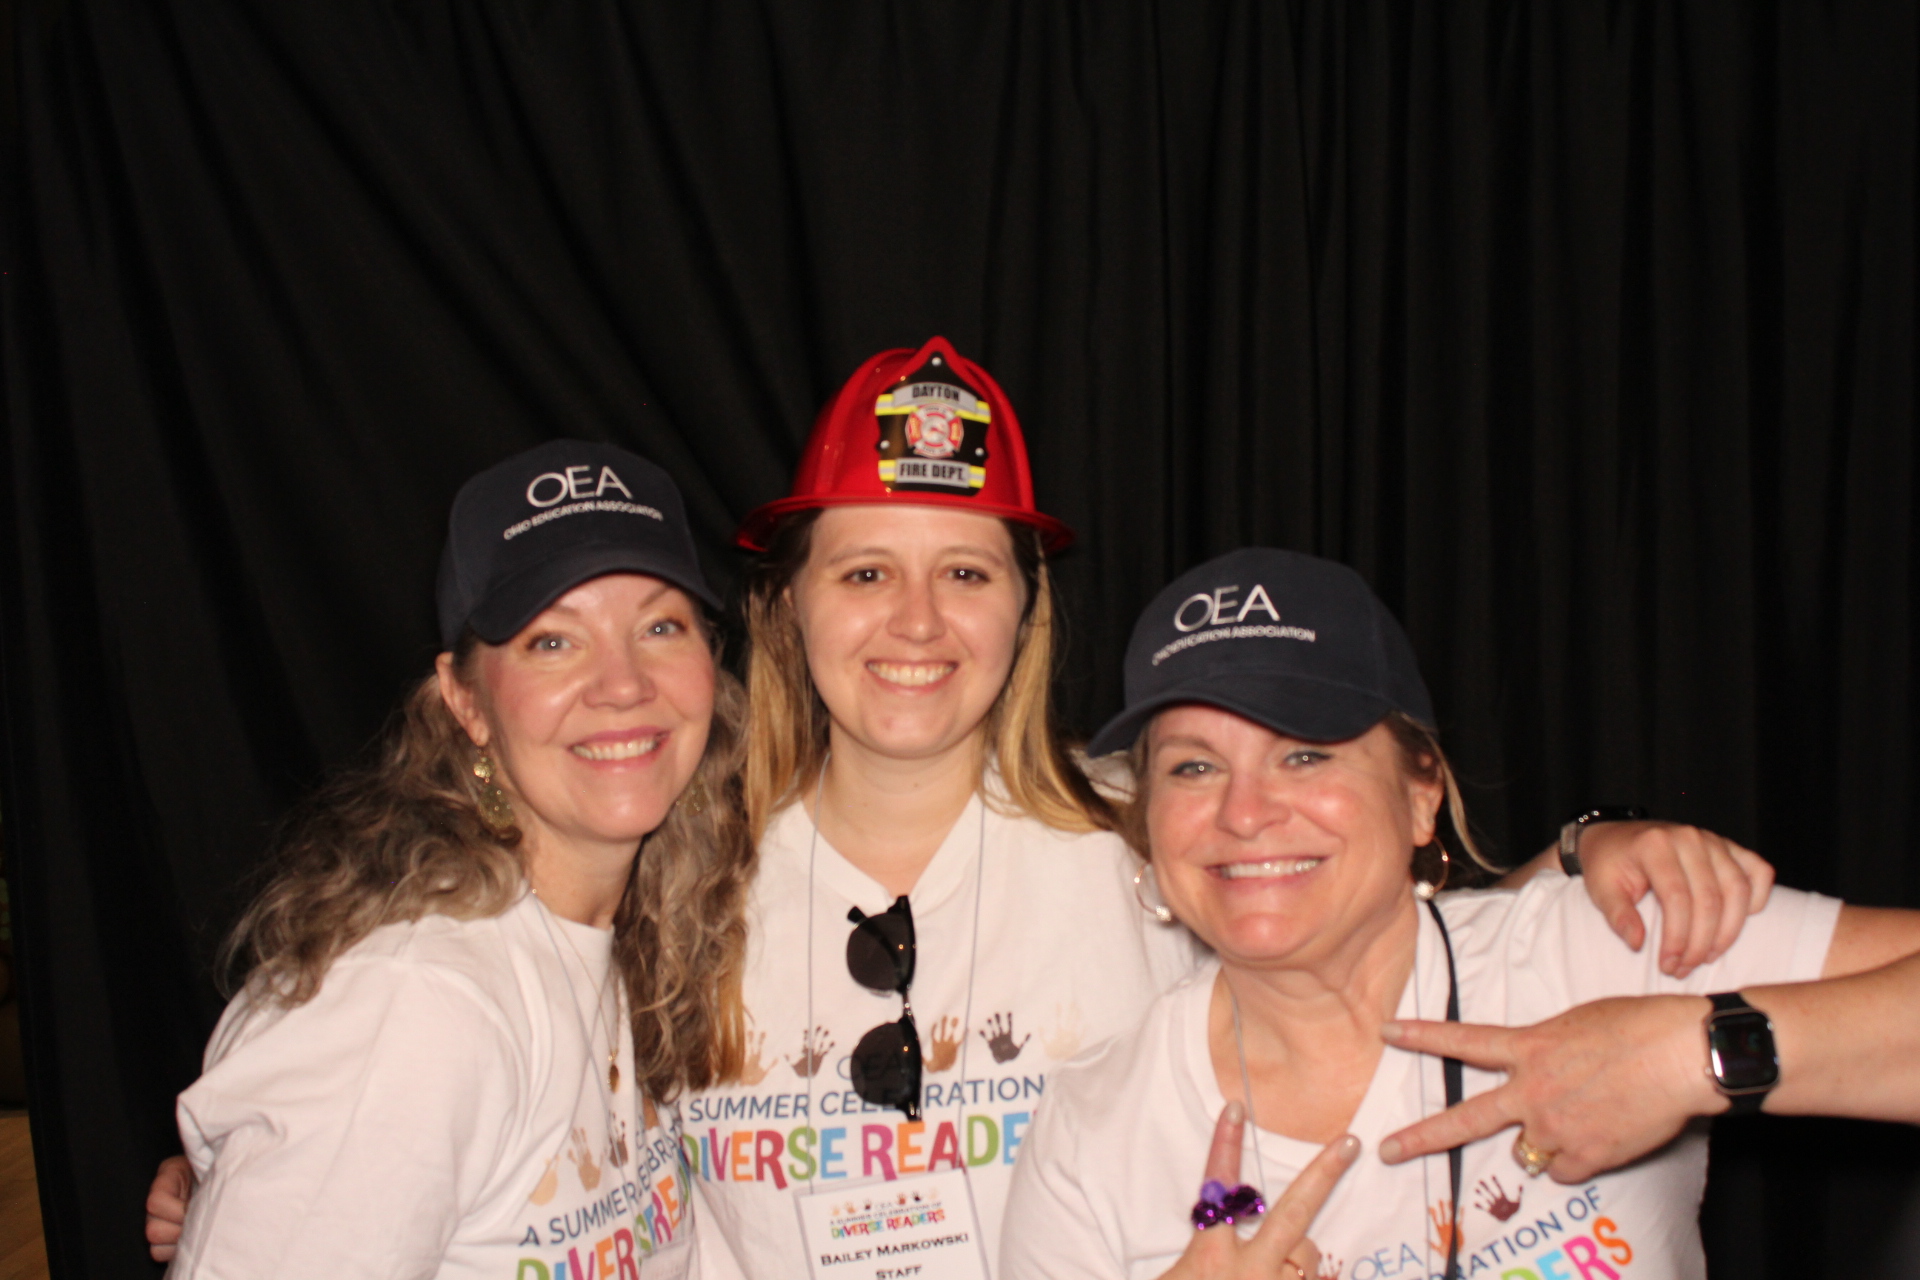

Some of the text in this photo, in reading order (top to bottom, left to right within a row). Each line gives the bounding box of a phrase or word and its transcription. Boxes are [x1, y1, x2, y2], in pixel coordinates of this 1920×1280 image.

[912, 385, 959, 401] DAYTON
[899, 463, 927, 477] FIRE
[526, 465, 633, 508] OEA
[503, 519, 532, 540] OHIO
[1173, 584, 1281, 633] OEA
[1230, 625, 1316, 642] ASSOCIATION
[689, 1093, 810, 1122] SUMMER
[518, 1224, 541, 1247] A
[549, 1181, 637, 1245] SUMMER
[1566, 1186, 1601, 1221] OF
[831, 1208, 945, 1239] DIVERSE READERS
[821, 1234, 969, 1266] BAILEY MARKOWSKI
[1350, 1243, 1425, 1280] OEA
[876, 1265, 923, 1280] STAFF
